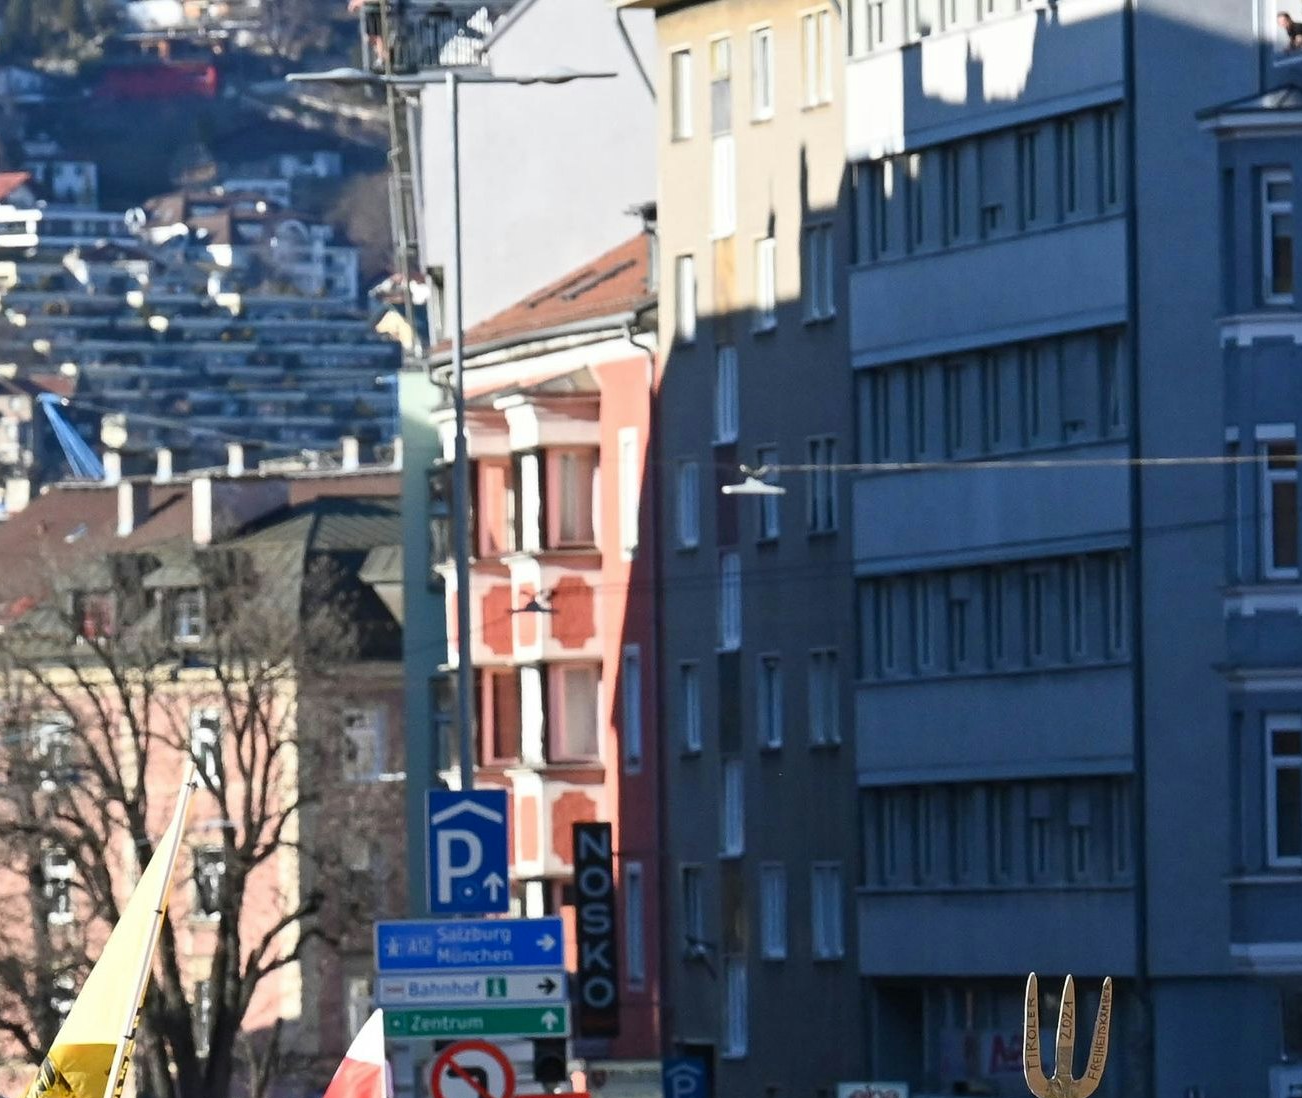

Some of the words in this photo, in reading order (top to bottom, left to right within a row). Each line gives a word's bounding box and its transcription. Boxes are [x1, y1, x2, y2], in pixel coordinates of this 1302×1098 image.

[437, 829, 483, 903] P
[579, 828, 615, 1009] NOSKO
[436, 926, 512, 946] Salzburg
[436, 948, 514, 964] München
[408, 979, 480, 997] Bahnhof
[411, 1015, 485, 1032] Zentrum
[1026, 998, 1039, 1071] TIROLER
[1061, 1001, 1074, 1040] 2021
